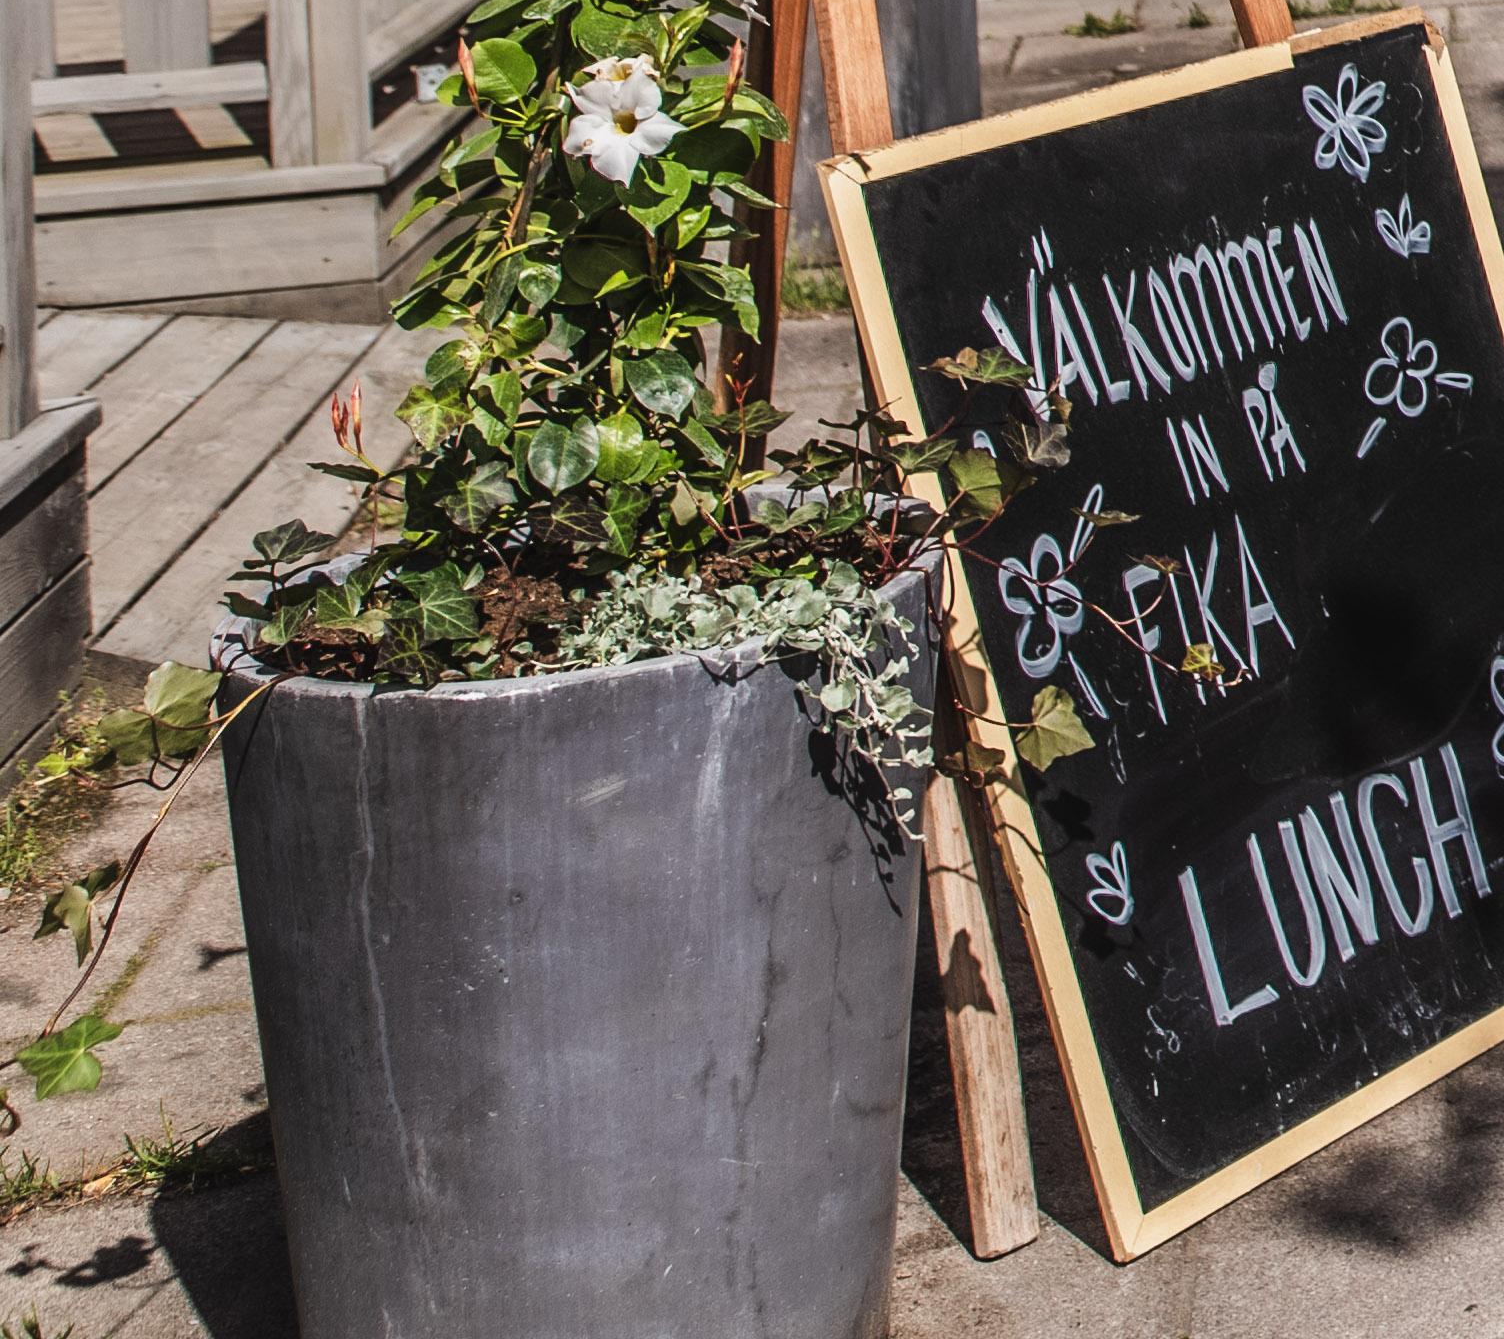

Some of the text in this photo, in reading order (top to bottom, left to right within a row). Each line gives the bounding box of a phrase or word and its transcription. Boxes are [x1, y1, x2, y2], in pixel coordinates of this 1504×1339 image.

[981, 216, 1350, 424] VÄLKOMMEN
[1165, 361, 1306, 505] IN PÅ
[1122, 510, 1297, 726] FIKA
[1177, 741, 1492, 1026] LUNCH
